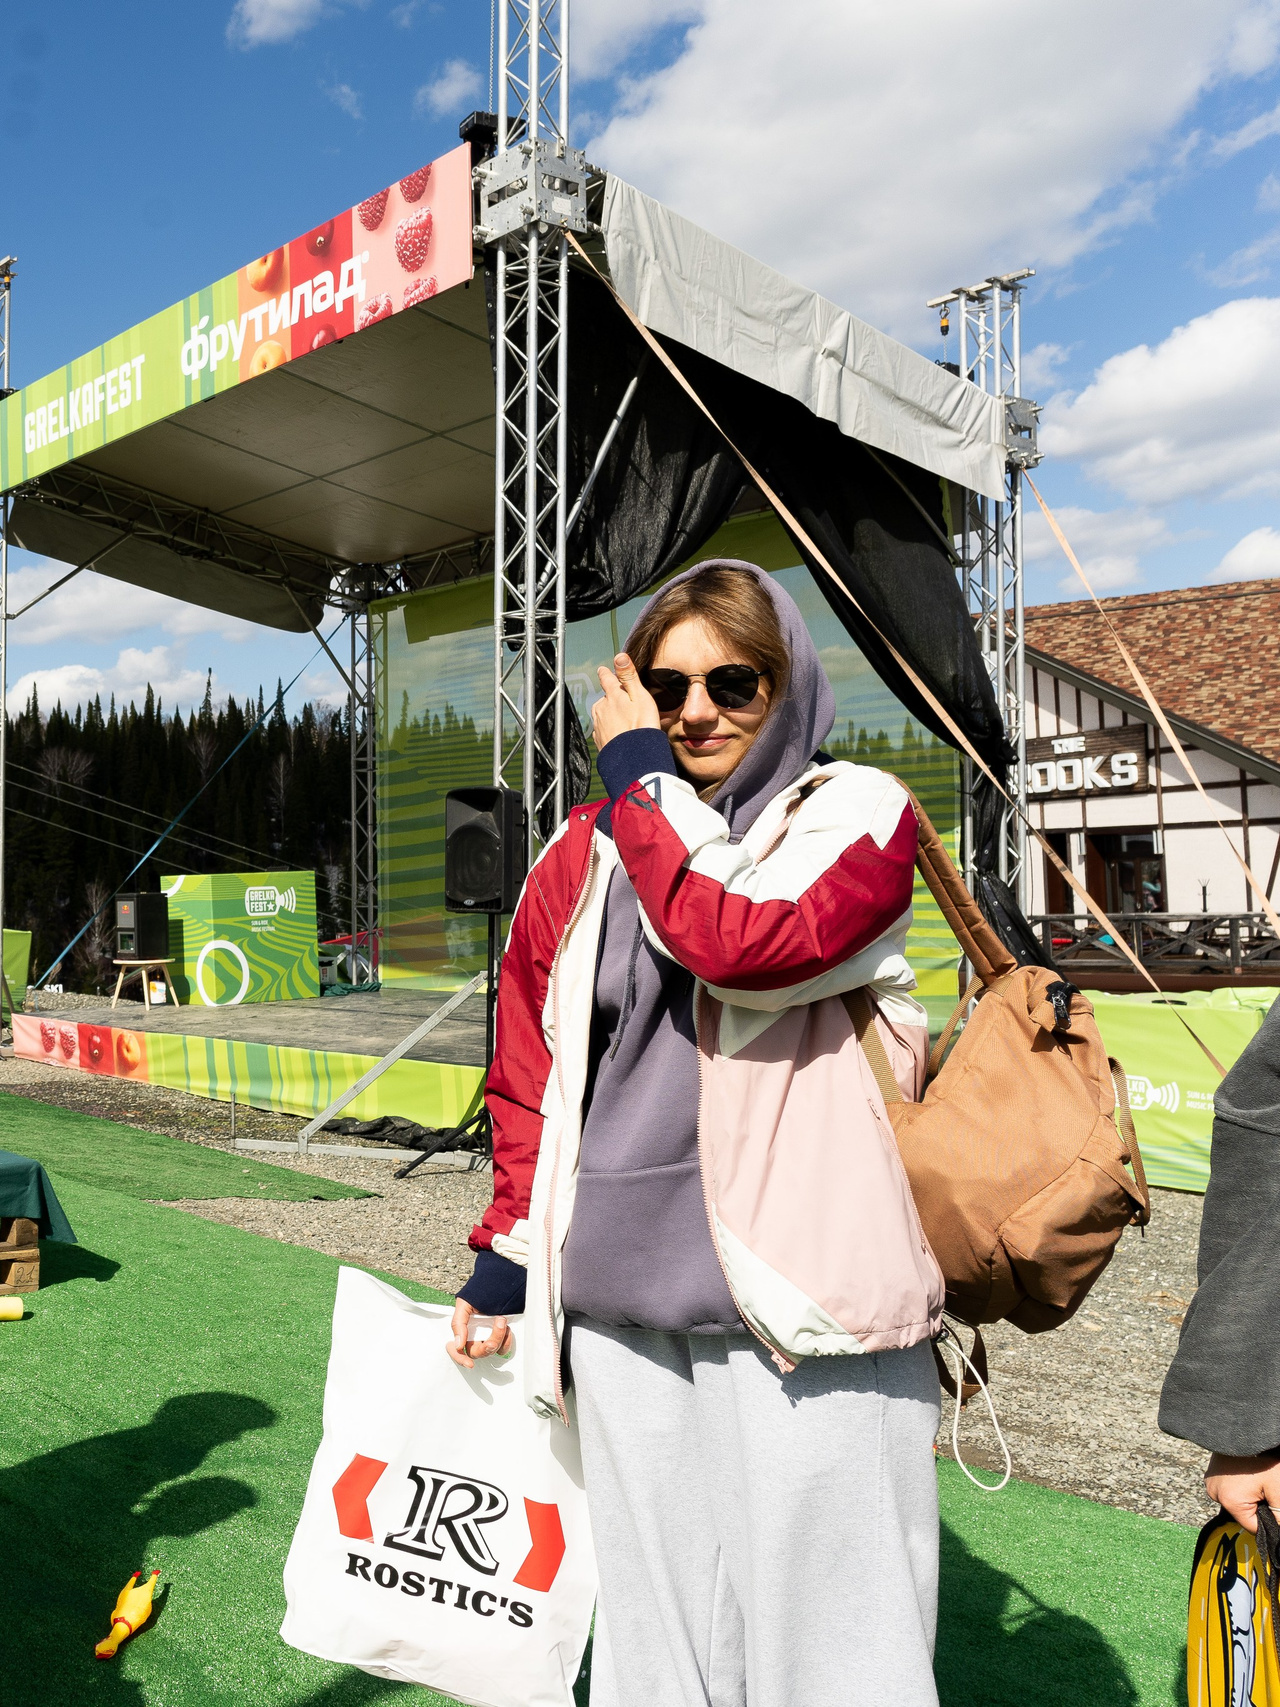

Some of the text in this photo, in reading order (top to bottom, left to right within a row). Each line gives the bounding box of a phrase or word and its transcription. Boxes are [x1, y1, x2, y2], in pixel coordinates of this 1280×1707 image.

[24, 354, 146, 455] GRELKAFEST
[1051, 736, 1086, 754] THE
[250, 901, 268, 912] FEST
[1127, 1079, 1145, 1093] LKA
[16, 1265, 36, 1284] 21
[383, 1465, 509, 1577] R
[345, 1552, 535, 1629] ROSTIC'S
